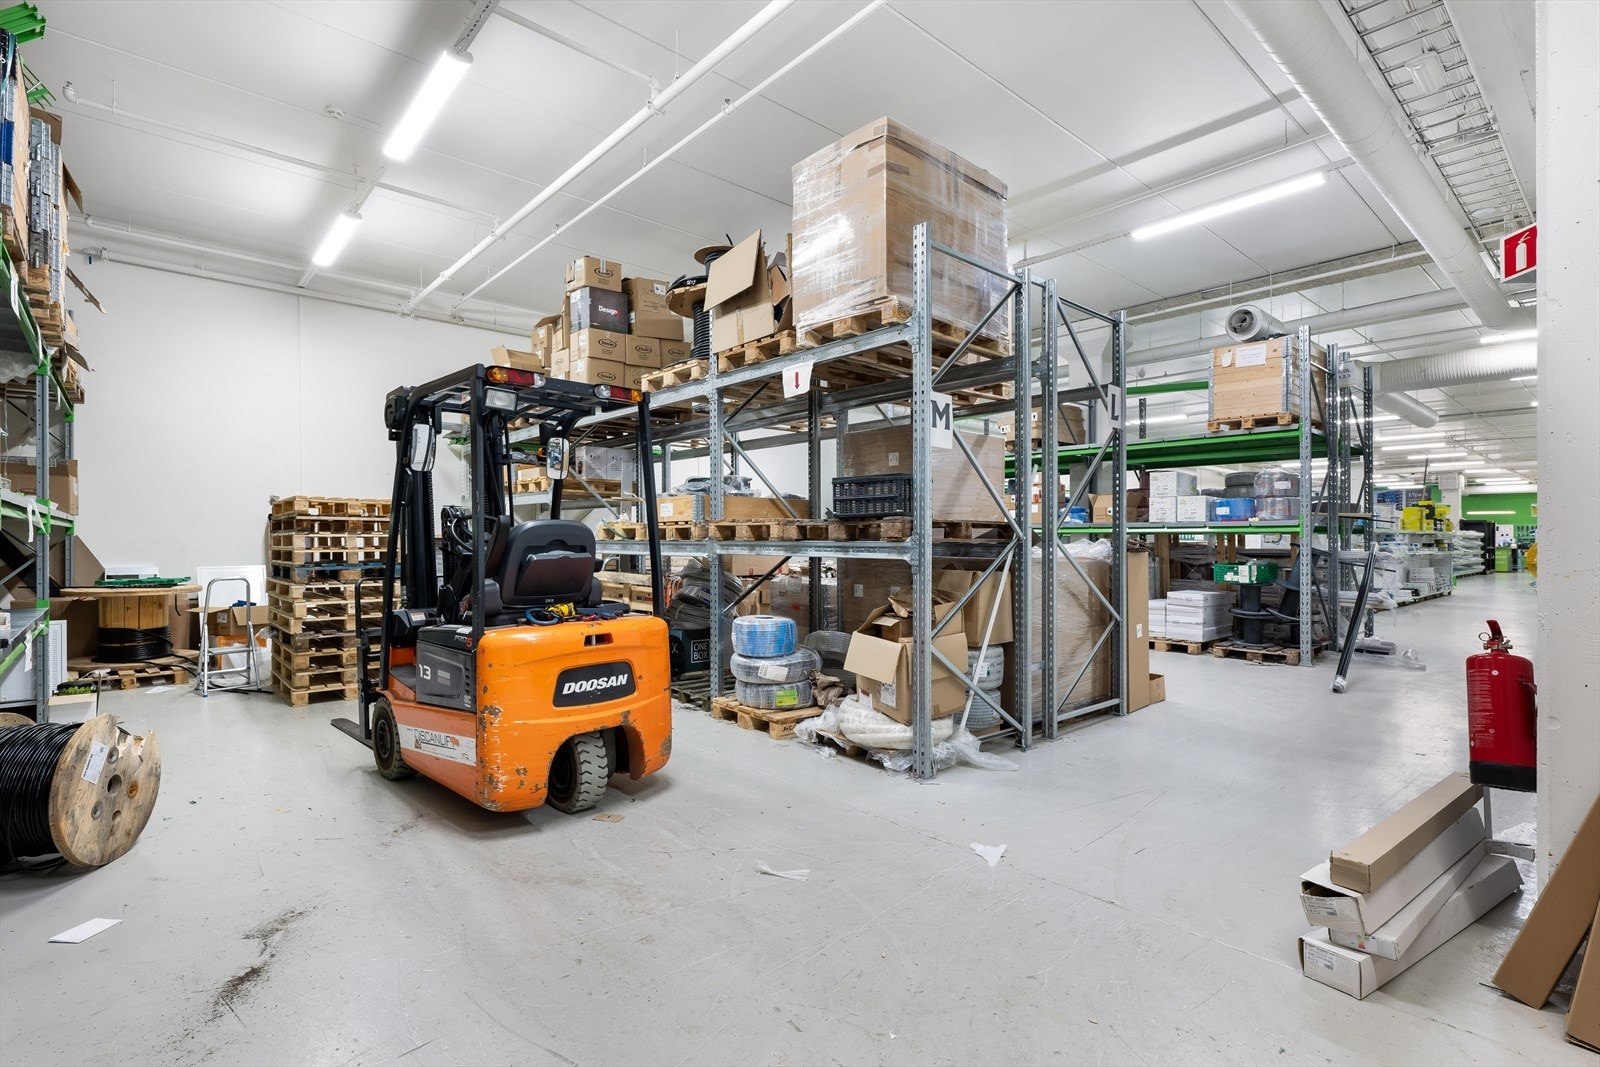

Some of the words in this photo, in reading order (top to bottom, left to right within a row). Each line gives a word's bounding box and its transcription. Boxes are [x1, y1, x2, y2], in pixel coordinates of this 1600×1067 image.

[930, 399, 951, 431] M
[1111, 393, 1119, 421] L
[693, 642, 708, 652] ONE
[693, 651, 708, 660] BOX
[418, 663, 432, 681] 13
[562, 673, 629, 695] DOOSAN
